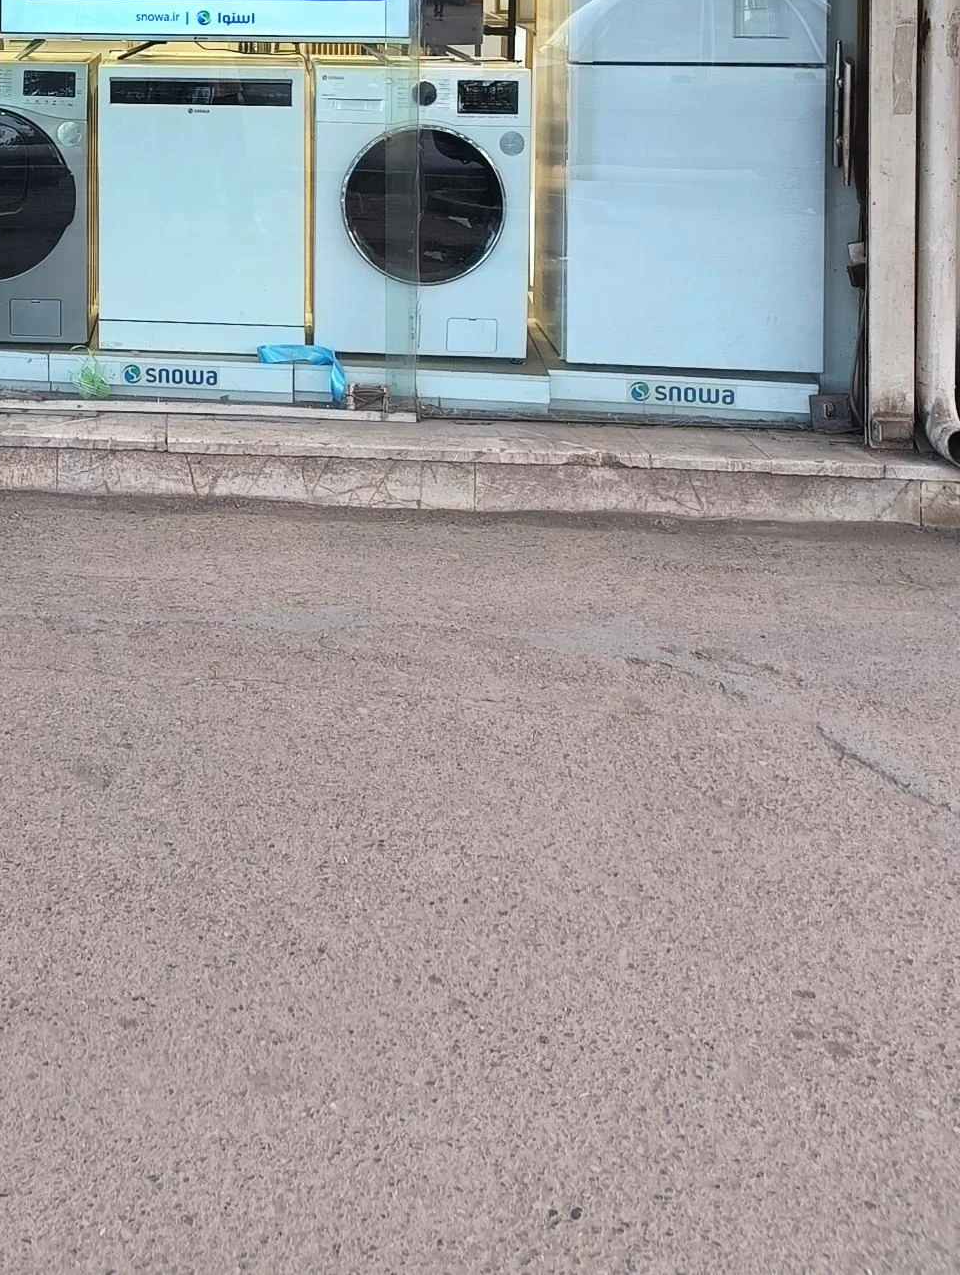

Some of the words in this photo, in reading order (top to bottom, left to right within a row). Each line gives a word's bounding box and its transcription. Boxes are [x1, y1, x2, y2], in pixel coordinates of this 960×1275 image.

[135, 12, 180, 22] snowa.ir
[218, 12, 255, 25] اسنوا
[145, 367, 219, 386] snowa
[655, 385, 735, 406] snowa
